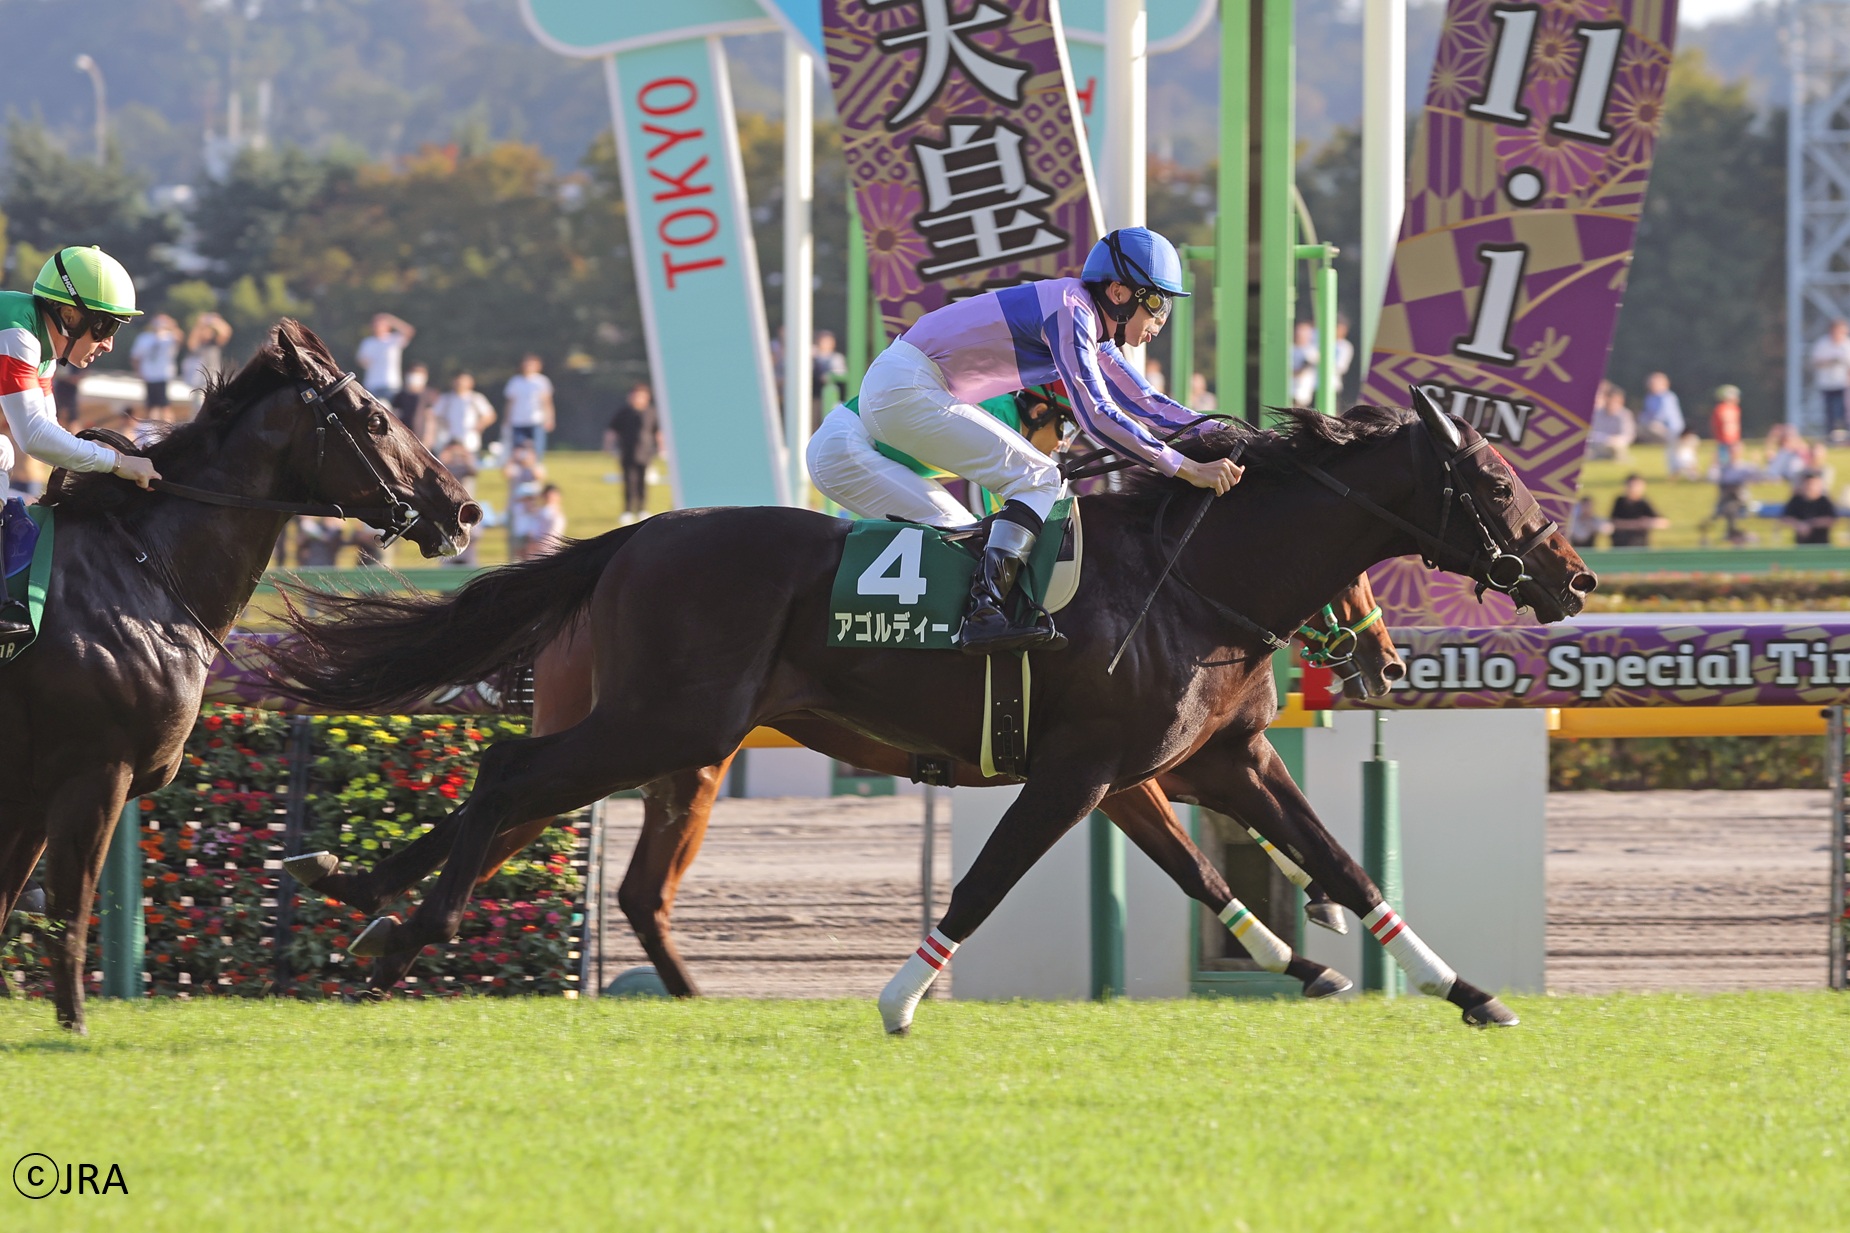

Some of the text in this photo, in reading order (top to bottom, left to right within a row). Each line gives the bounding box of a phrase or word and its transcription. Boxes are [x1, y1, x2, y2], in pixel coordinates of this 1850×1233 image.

[636, 76, 726, 290] TOKYO
[857, 527, 927, 605] 4
[1547, 643, 1754, 698] Special
